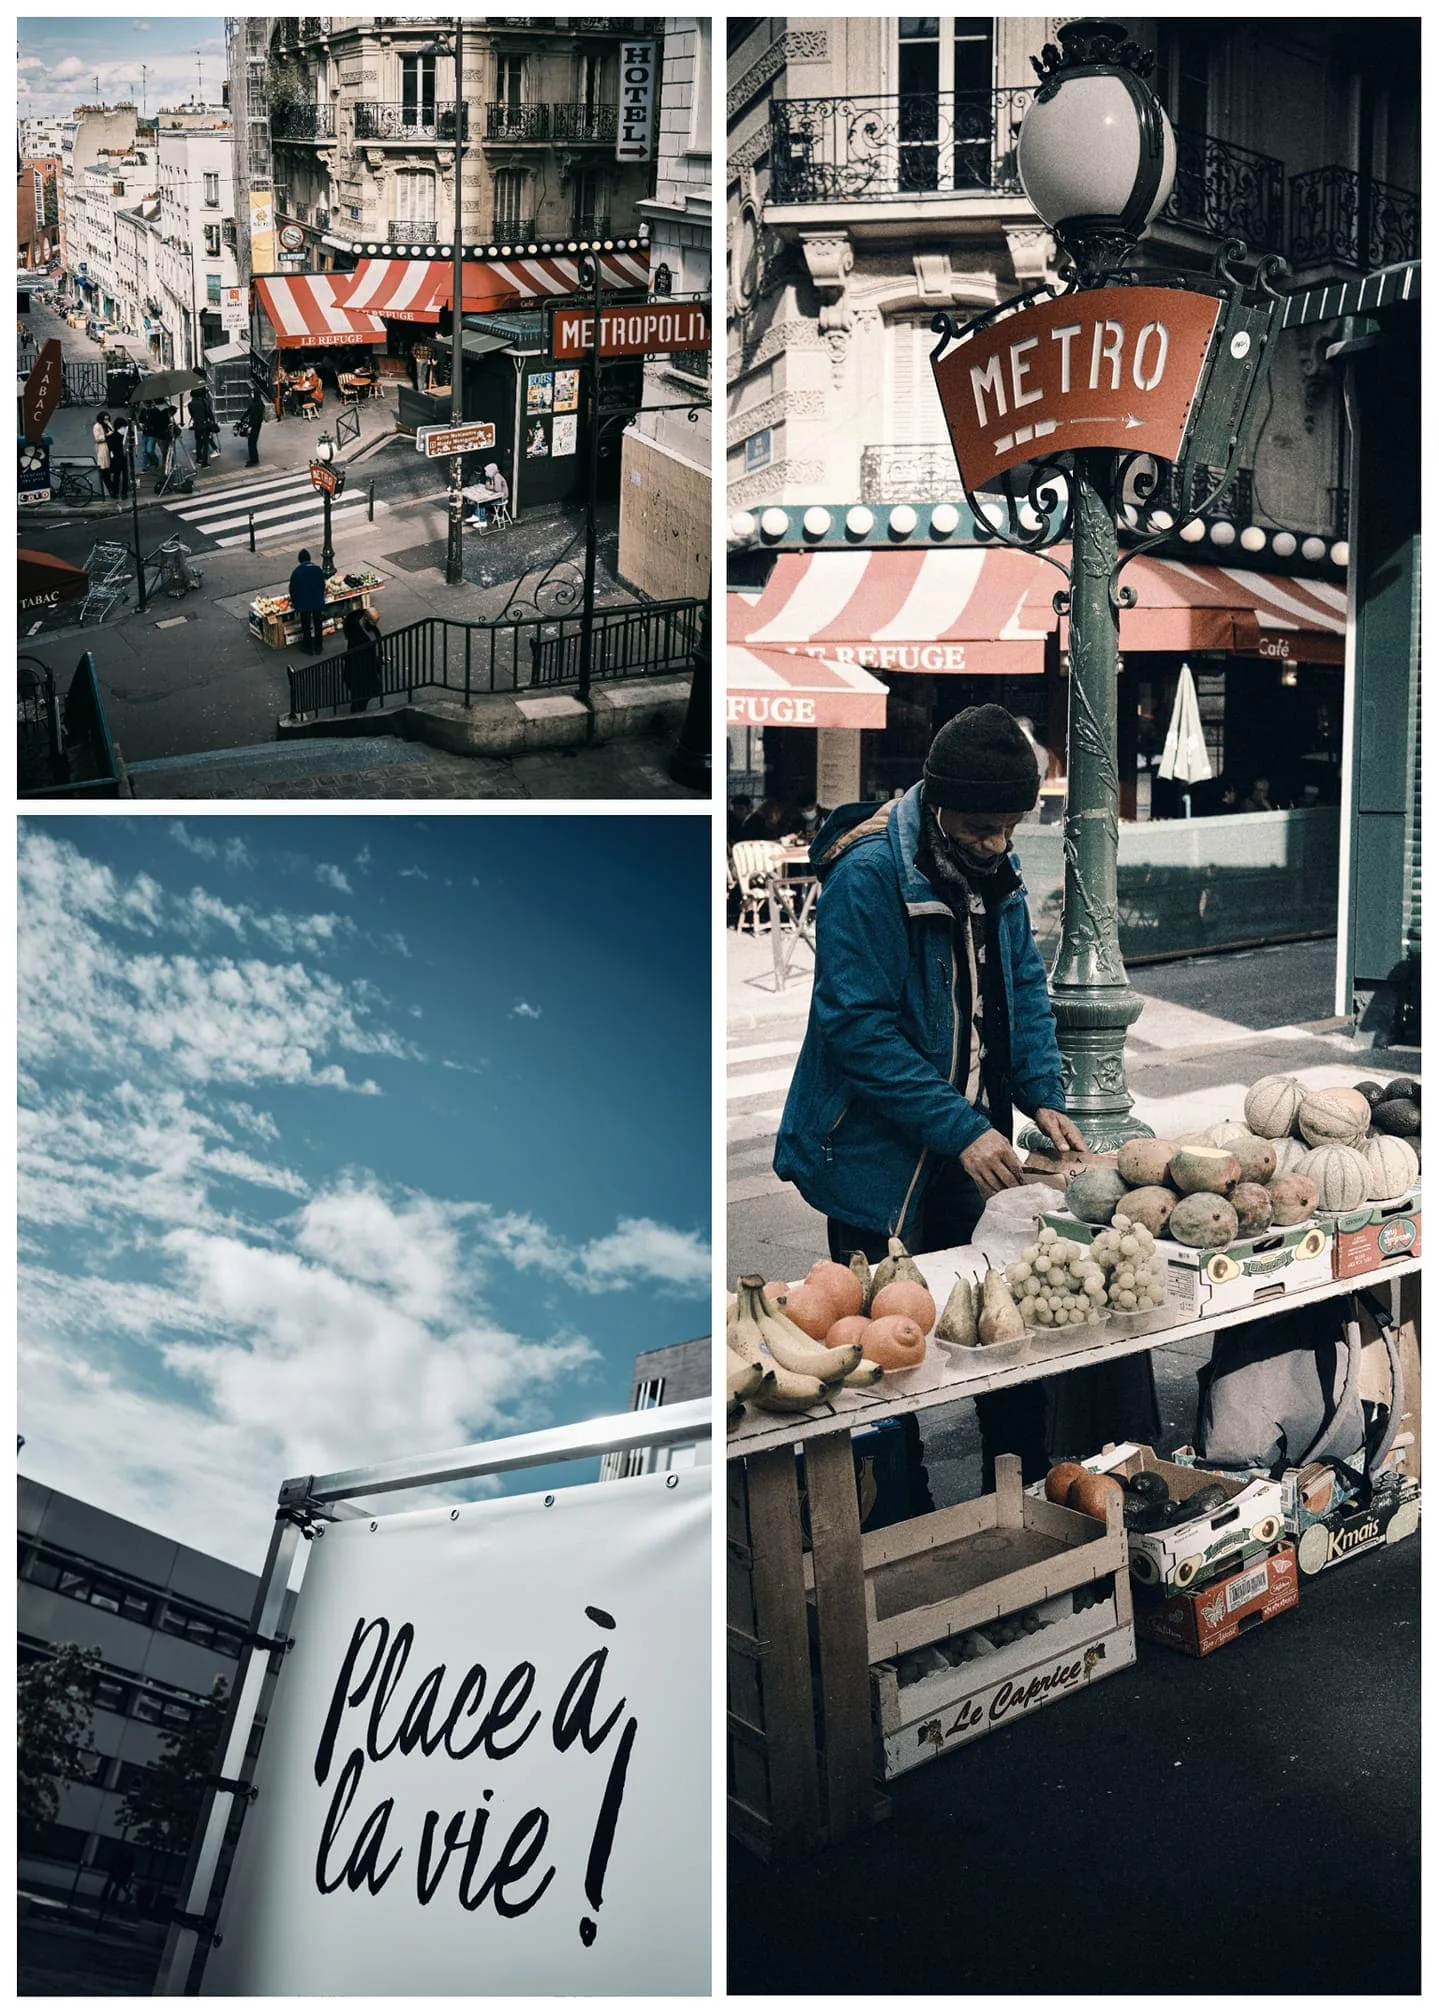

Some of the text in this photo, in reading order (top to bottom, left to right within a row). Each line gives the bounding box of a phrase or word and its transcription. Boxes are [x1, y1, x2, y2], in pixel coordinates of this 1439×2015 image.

[623, 47, 651, 142] HOTEL
[301, 335, 364, 345] LE REFUGE
[970, 318, 1169, 428] METRO
[33, 361, 54, 422] TABAC
[22, 590, 60, 609] TABAC
[835, 645, 967, 670] REFUGE
[1259, 638, 1289, 658] Café
[315, 1605, 627, 1787] Place à
[945, 1661, 1082, 1738] Le Caprice
[316, 1747, 403, 1895] la
[417, 1789, 556, 1919] vie
